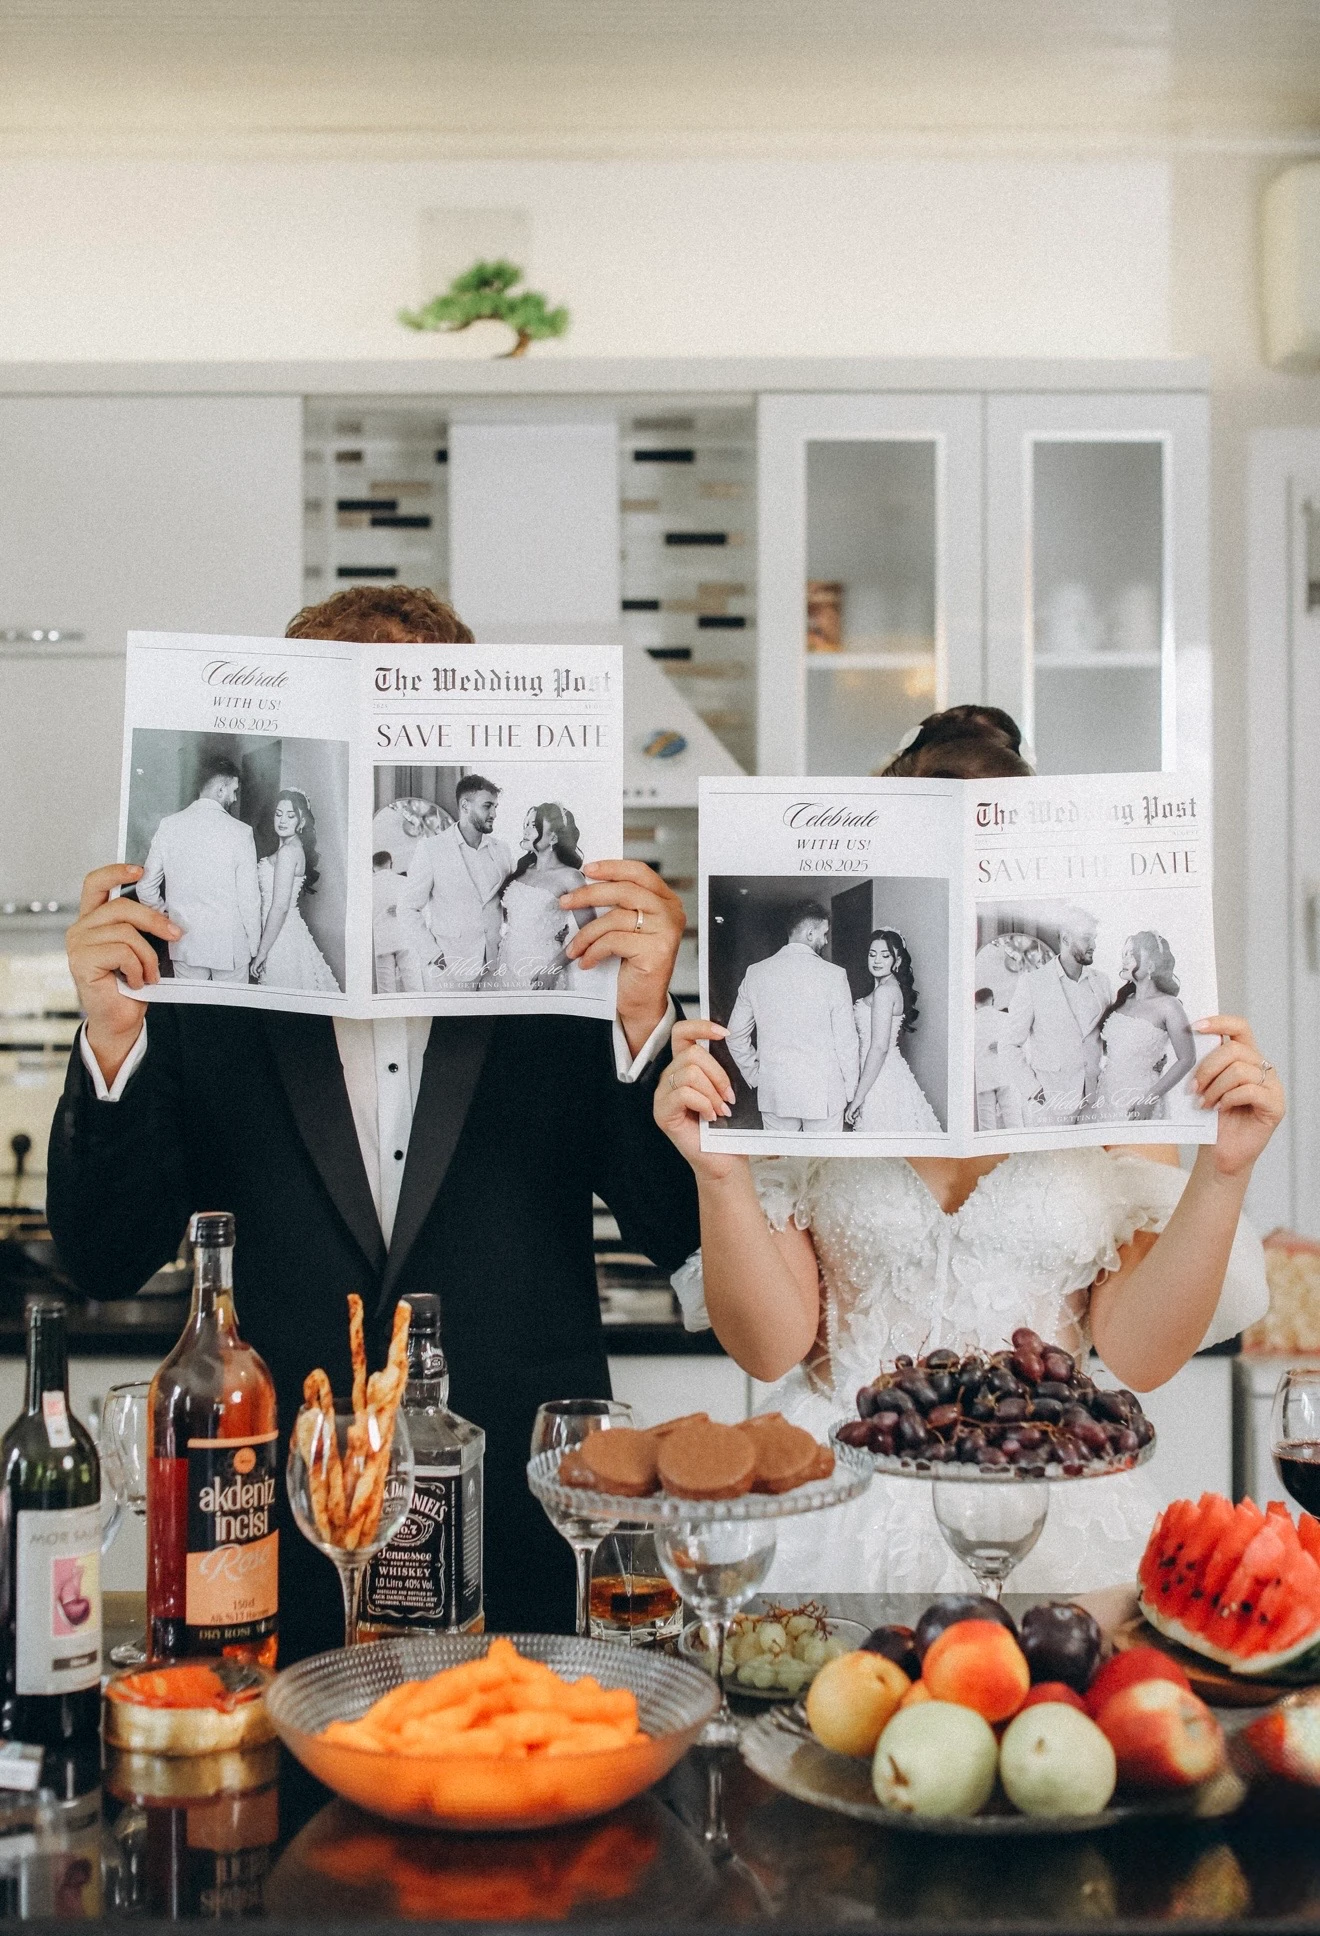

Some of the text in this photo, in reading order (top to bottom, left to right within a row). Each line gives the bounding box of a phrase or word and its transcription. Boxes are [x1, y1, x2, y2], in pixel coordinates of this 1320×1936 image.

[202, 660, 289, 687] Celebrate
[374, 667, 611, 698] The Wedding Post
[213, 696, 281, 711] WITH US!
[213, 716, 278, 732] 18.08.2025
[377, 723, 609, 748] SAVE THE DATE
[783, 802, 880, 829] Celebrate
[976, 802, 1019, 832] The
[1142, 795, 1197, 825] Post
[797, 839, 871, 851] WITH US!
[799, 858, 868, 872] 18.08.2025
[978, 857, 1049, 883] SAVE
[1130, 851, 1197, 876] DATE
[493, 960, 508, 977] &
[458, 981, 499, 989] GETTING
[1091, 1094, 1105, 1109] &
[199, 1474, 275, 1512] akdeniz
[214, 1504, 268, 1541] incisi
[377, 1547, 432, 1561] Tennessee
[379, 1566, 431, 1578] WHISKEY
[404, 1579, 420, 1589] 40%
